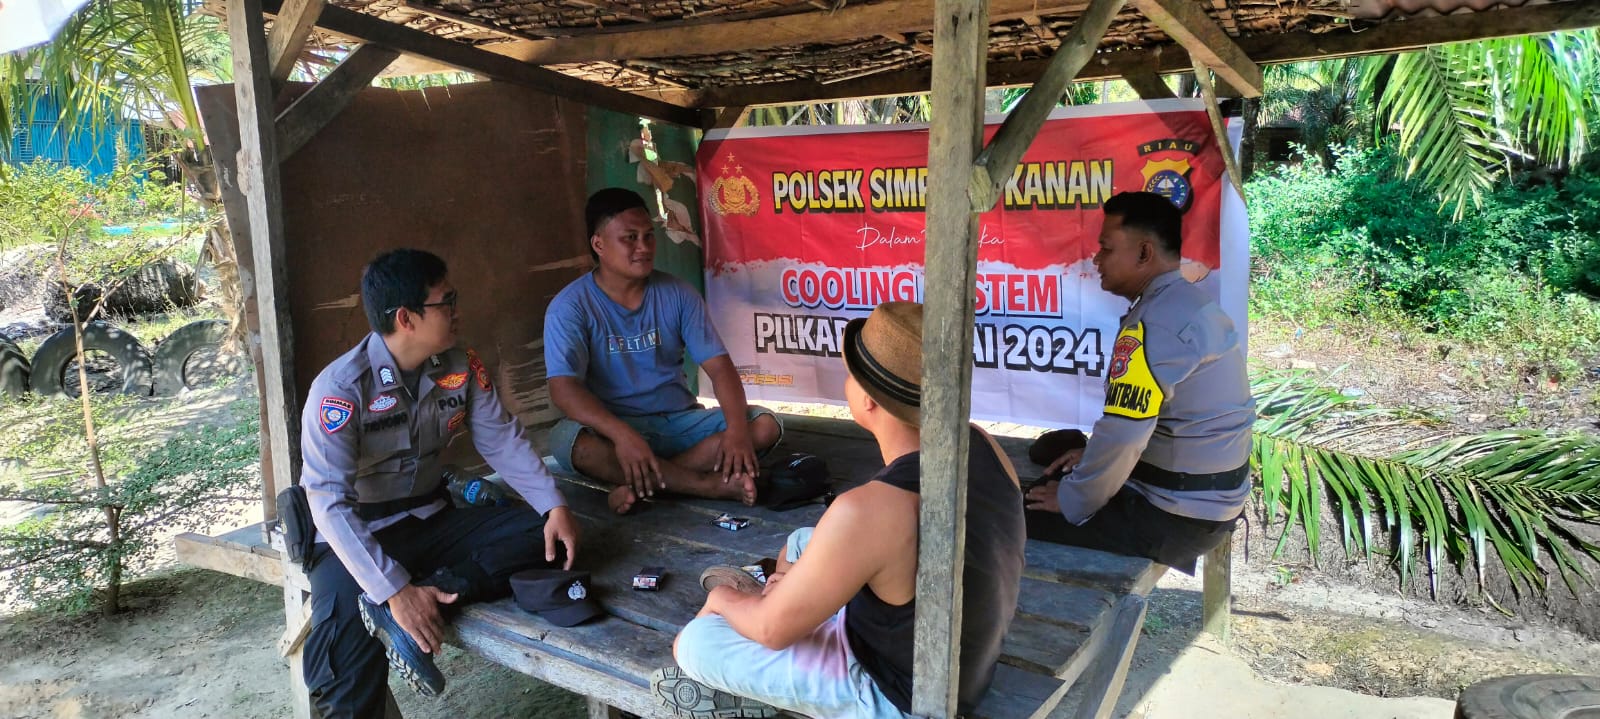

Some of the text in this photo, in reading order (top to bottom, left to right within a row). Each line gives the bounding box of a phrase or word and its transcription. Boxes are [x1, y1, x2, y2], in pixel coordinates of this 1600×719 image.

[1143, 141, 1193, 153] RIAU
[773, 170, 864, 213] POLSEK
[1004, 159, 1113, 209] KANAN
[856, 222, 920, 250] Dalam
[781, 269, 917, 309] COOLING
[1004, 323, 1104, 377] 2024
